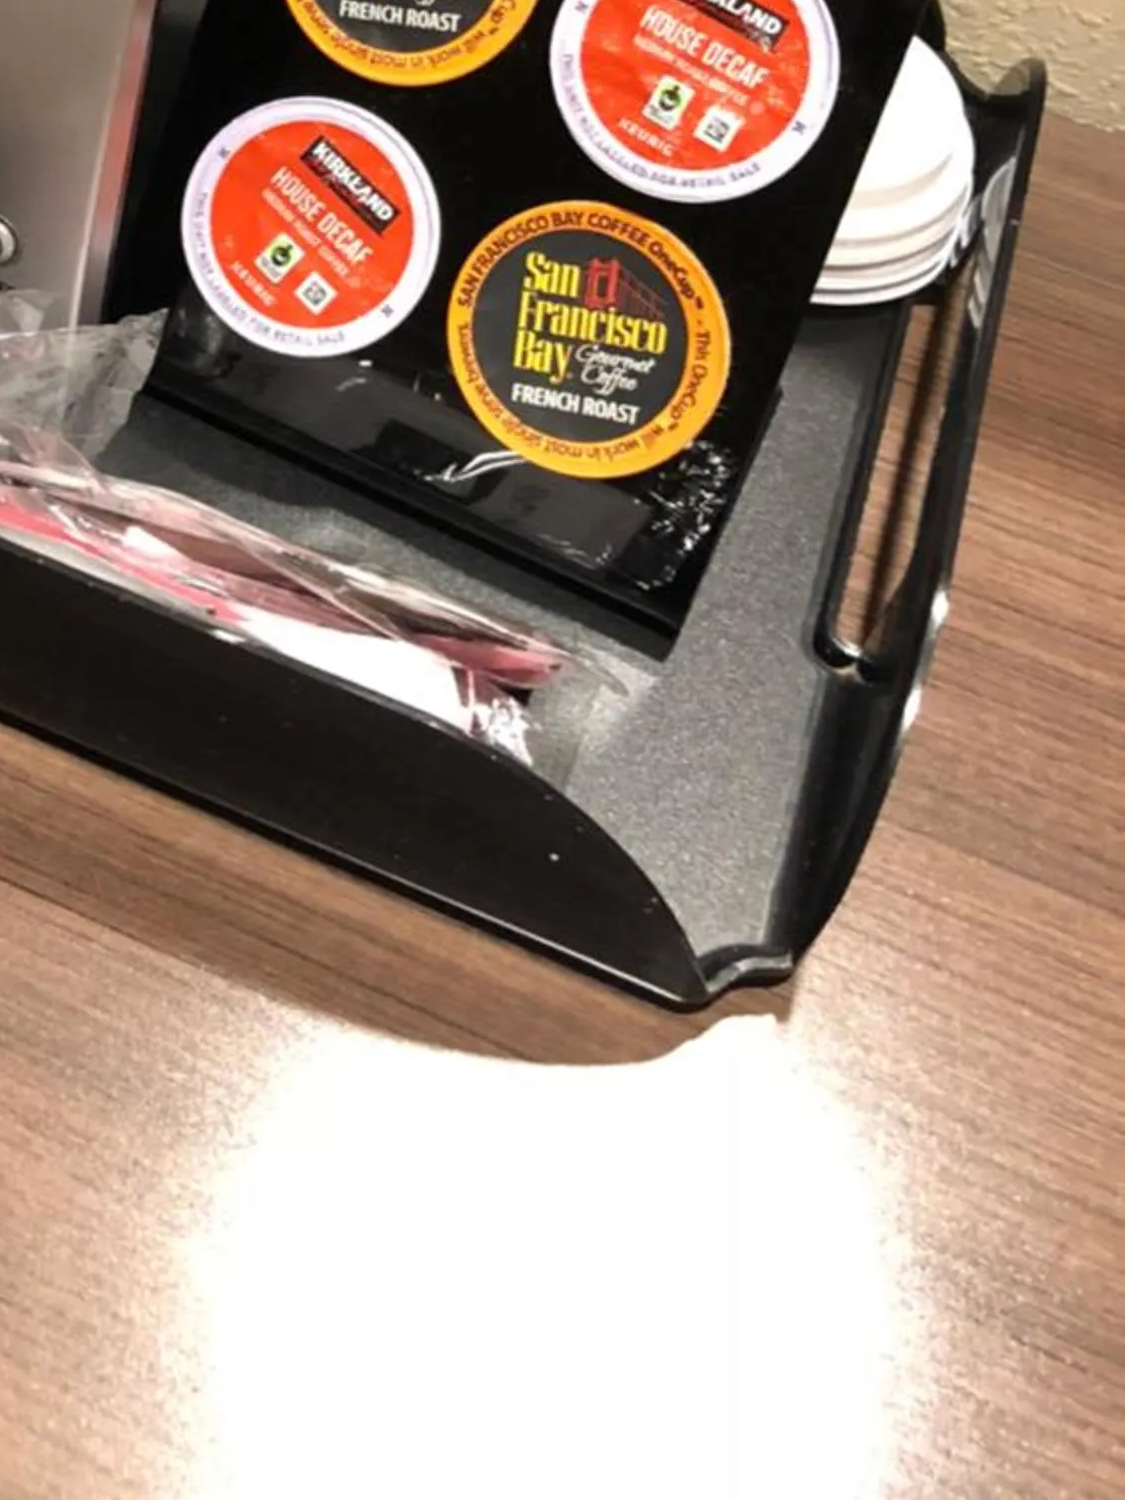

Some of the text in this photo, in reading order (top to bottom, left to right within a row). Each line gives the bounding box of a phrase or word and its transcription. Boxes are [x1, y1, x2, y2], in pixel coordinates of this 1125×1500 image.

[339, 0, 462, 32] FRENCH ROAST
[640, 4, 708, 57] HOUSE
[701, 40, 770, 89] DECAF
[312, 141, 394, 221] KIRKLAND
[270, 166, 327, 222] HOUSE
[316, 211, 375, 265] DECAF
[458, 271, 480, 306] SAN
[475, 214, 549, 272] FRANCISCO
[550, 209, 584, 225] BAY
[587, 211, 648, 245] COFFEE
[524, 251, 580, 299] San
[519, 291, 667, 355] Francisco
[513, 330, 573, 384] Bay
[575, 344, 658, 374] Gourmet
[581, 365, 638, 396] Coffee
[511, 383, 640, 425] FRENCH ROAST
